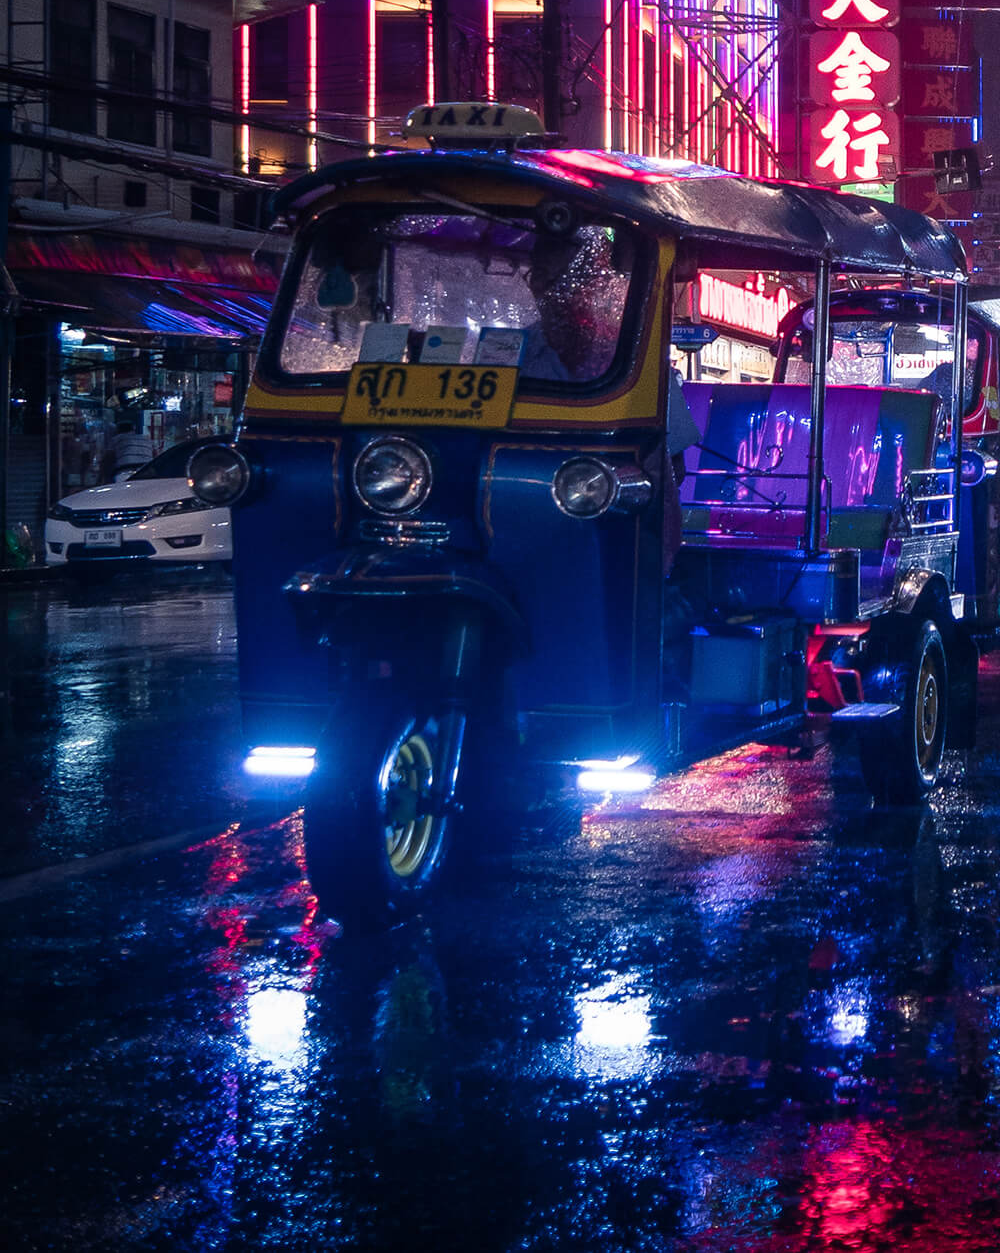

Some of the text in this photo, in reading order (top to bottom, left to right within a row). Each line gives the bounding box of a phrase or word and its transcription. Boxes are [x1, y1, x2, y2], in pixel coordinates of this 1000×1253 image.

[421, 105, 507, 127] TAXI
[703, 328, 710, 338] 6
[438, 369, 499, 401] 136
